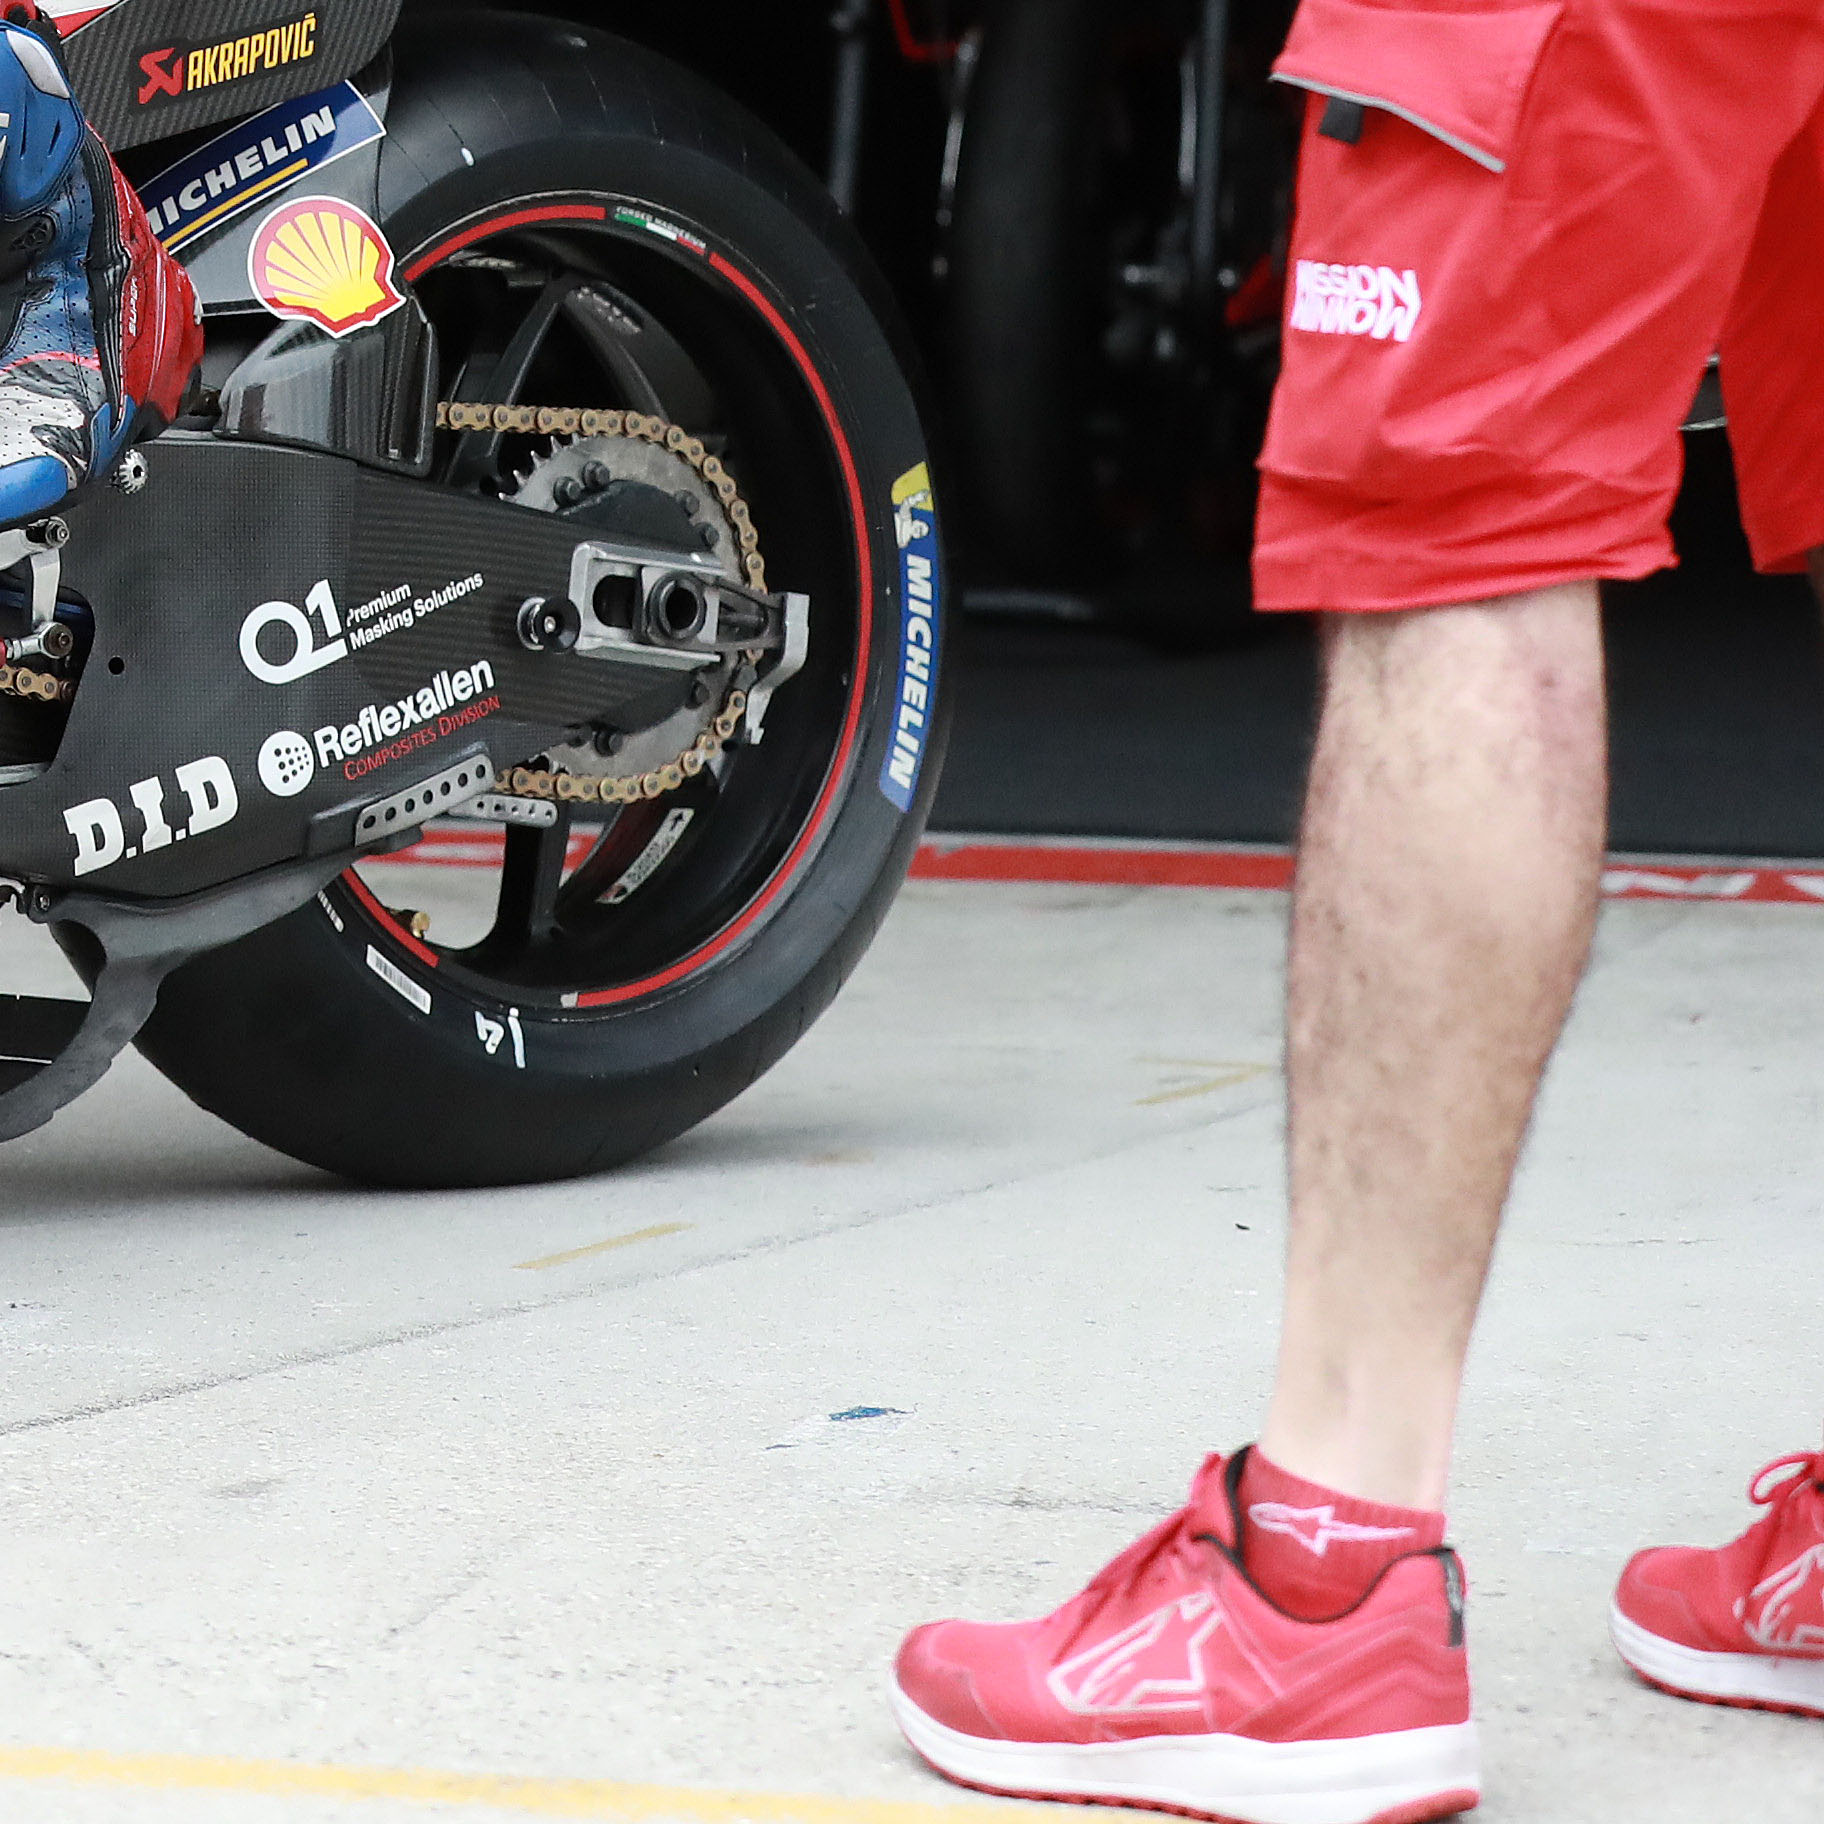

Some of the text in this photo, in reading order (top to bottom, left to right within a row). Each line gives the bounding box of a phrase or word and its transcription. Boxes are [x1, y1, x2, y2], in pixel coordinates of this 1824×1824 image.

[346, 583, 412, 628] Premium
[349, 572, 484, 651] Masking Solutions
[313, 659, 496, 769] Reflexallen
[887, 552, 932, 791] MICHELIN
[62, 756, 240, 878] D.I.D
